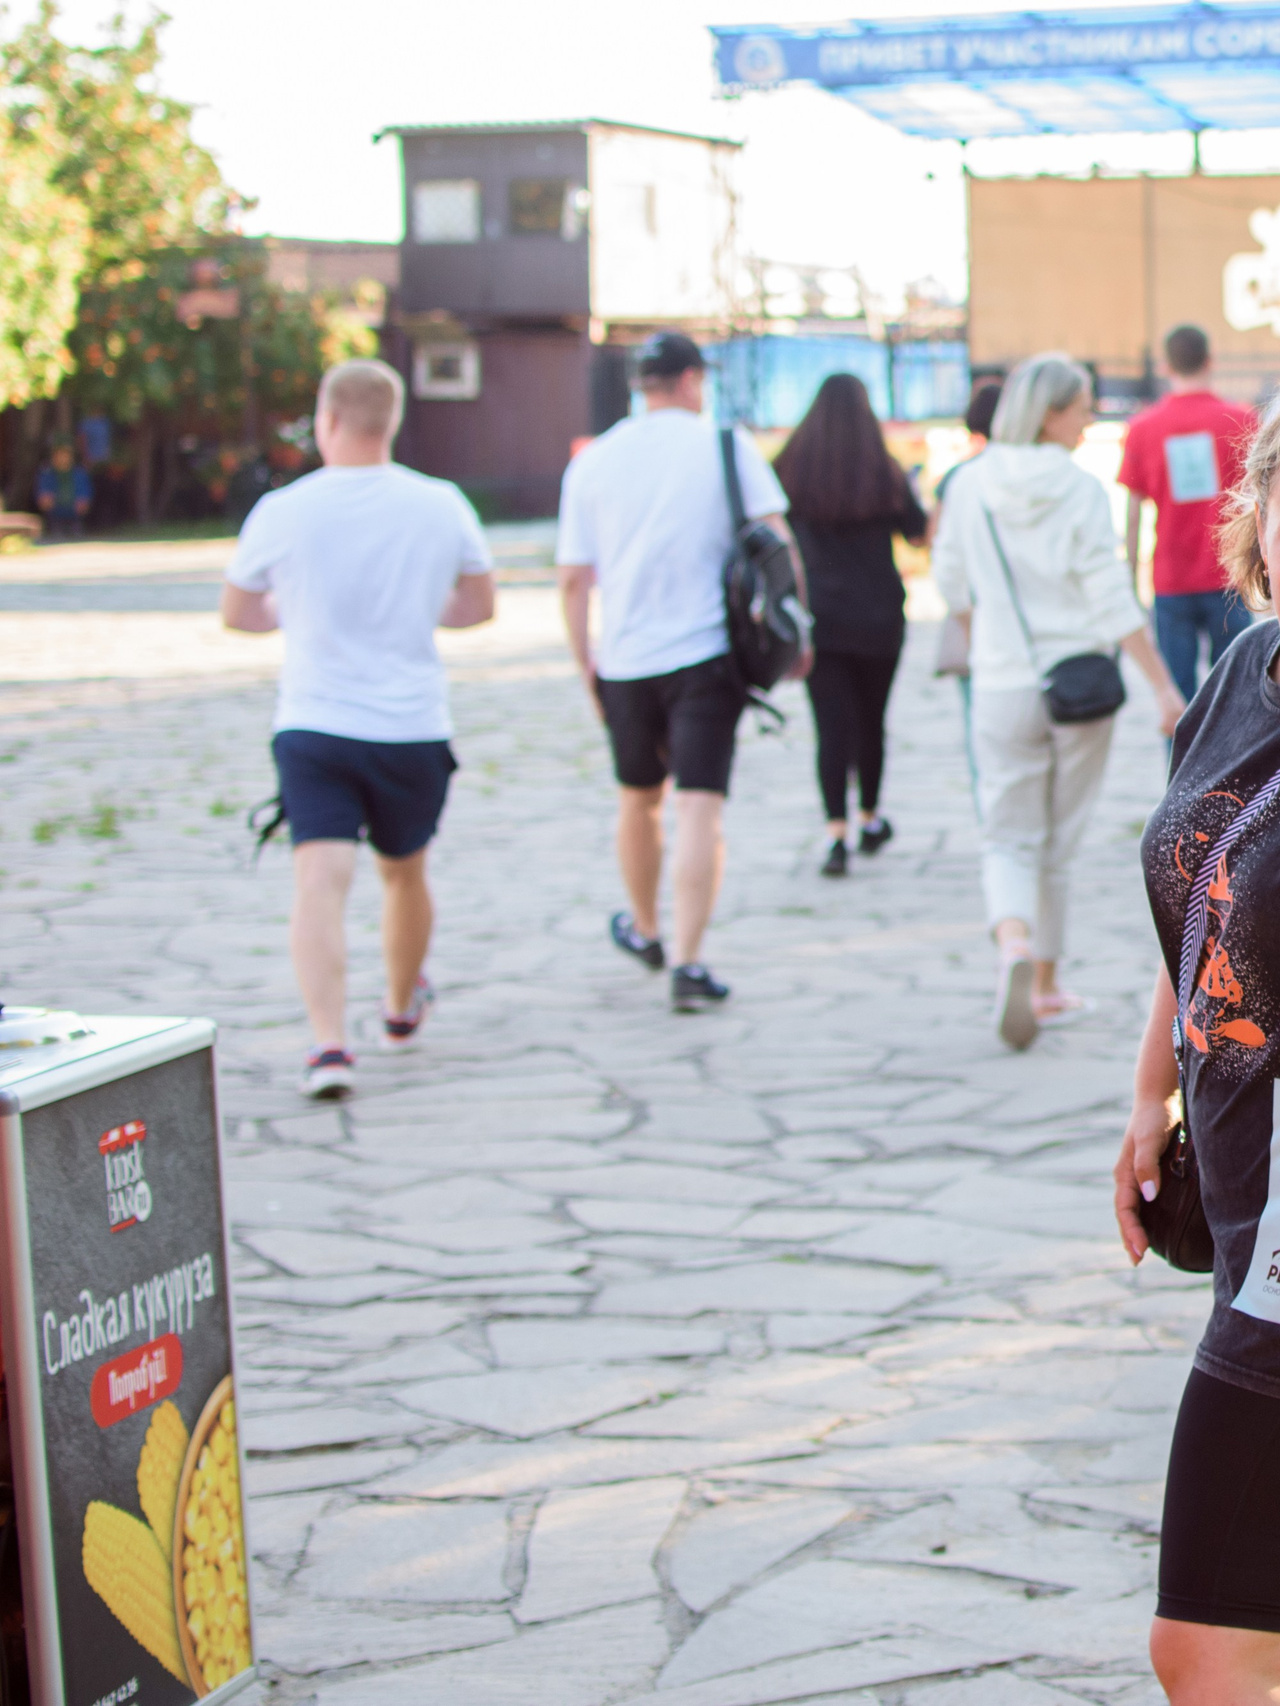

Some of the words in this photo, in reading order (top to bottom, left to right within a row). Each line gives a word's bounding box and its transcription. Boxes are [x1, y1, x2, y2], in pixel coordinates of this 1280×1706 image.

[43, 1289, 130, 1375] Сладкая
[133, 1252, 215, 1341] кукуруза
[108, 1347, 168, 1410] Попробуй!
